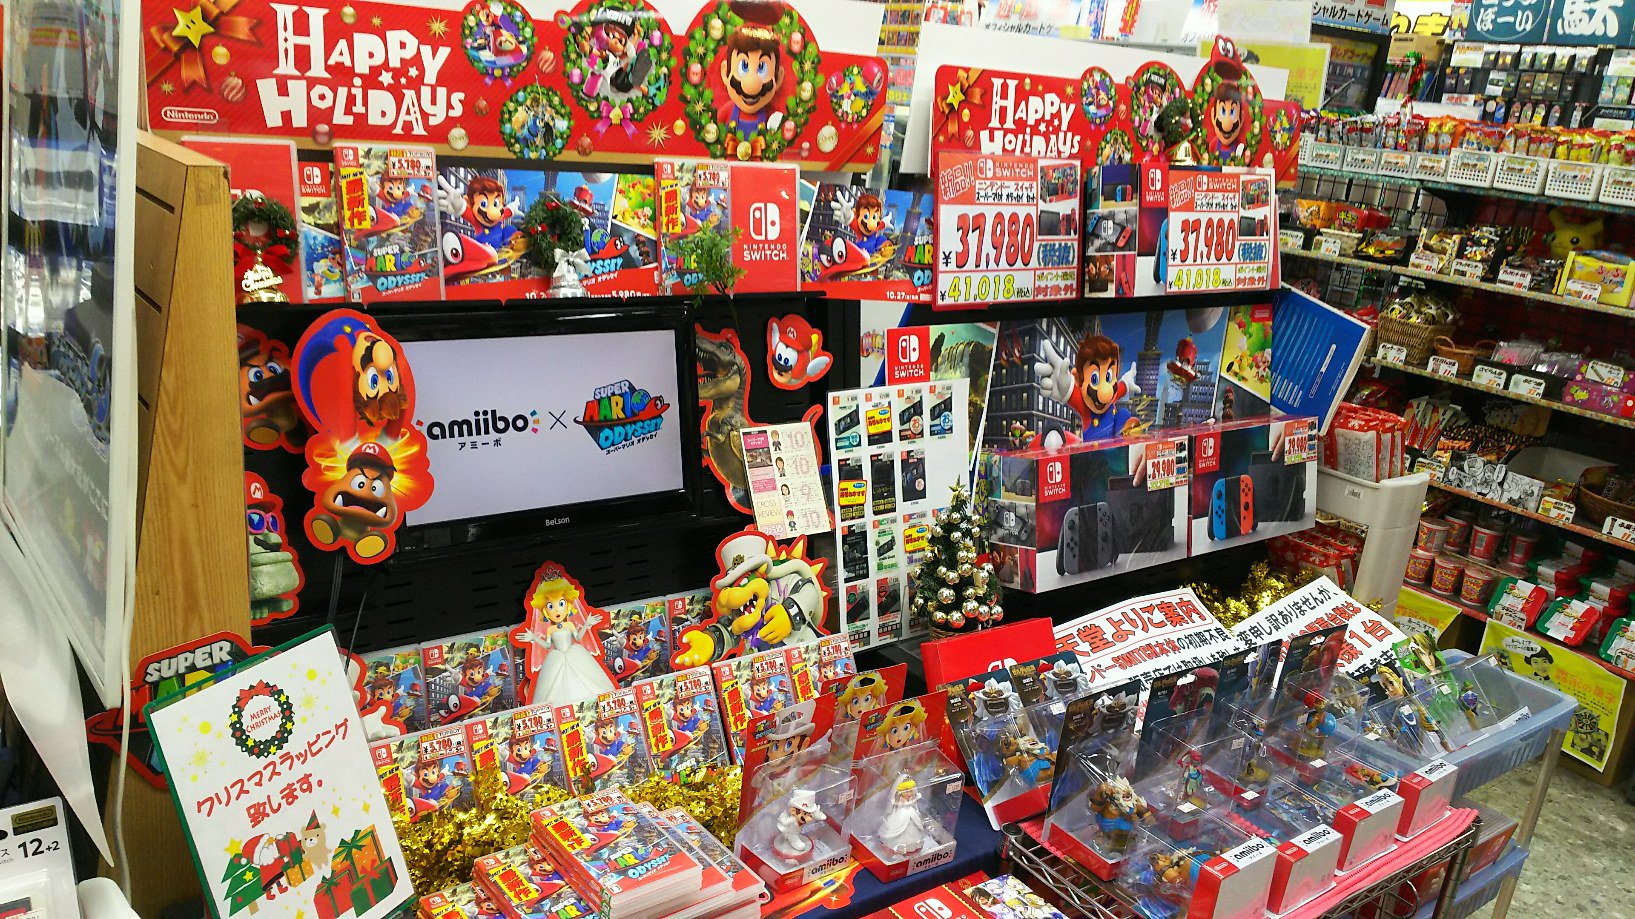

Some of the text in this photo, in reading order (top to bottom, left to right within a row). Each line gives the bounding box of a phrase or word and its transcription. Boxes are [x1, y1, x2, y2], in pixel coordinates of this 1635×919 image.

[268, 2, 452, 85] HAPPY
[990, 77, 1076, 132] HAPPY
[164, 108, 217, 122] Nintendo
[995, 168, 1034, 178] SWITCH
[743, 243, 787, 251] NINTENDO
[743, 250, 788, 261] SWITCH
[895, 368, 925, 379] SWITCH
[594, 379, 630, 400] SUPER
[583, 388, 651, 422] MARIO
[426, 408, 530, 441] amiibo
[599, 416, 664, 449] ODYSSEY
[457, 437, 502, 451] アミーボ
[1044, 487, 1067, 497] SWITCH
[145, 640, 233, 683] SUPER
[246, 710, 281, 734] CHRISTMAS
[250, 705, 272, 722] MERRY
[197, 718, 349, 818] クリスマスラッピング
[246, 773, 324, 828] 致します。
[1302, 828, 1331, 846] amiibo
[915, 850, 950, 868] amiibo
[1233, 843, 1265, 860] amiibo
[811, 855, 845, 875] amiibo
